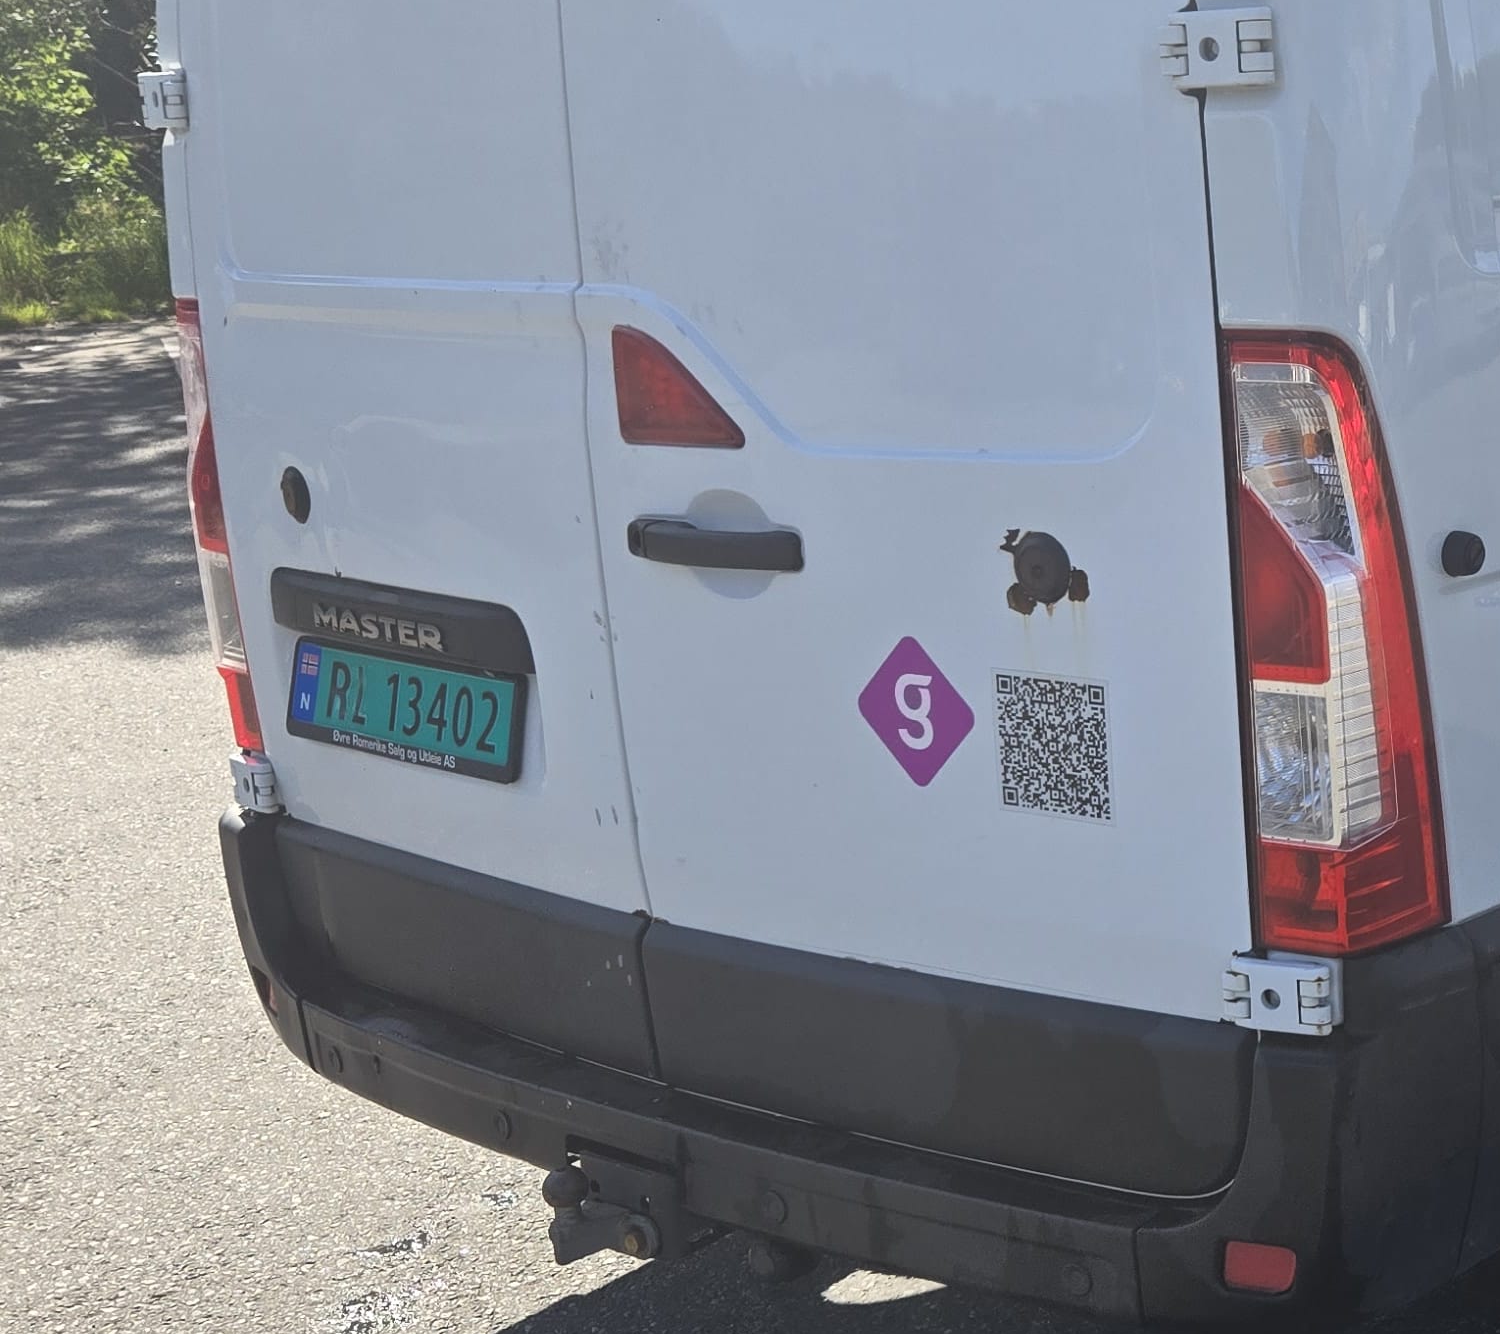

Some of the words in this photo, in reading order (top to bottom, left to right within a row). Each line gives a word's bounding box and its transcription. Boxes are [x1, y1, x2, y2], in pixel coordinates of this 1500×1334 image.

[312, 603, 445, 652] MASTER
[300, 692, 311, 711] N
[326, 660, 367, 725] RL
[386, 671, 499, 754] 13402
[894, 673, 934, 751] g
[332, 729, 351, 745] Øvre
[388, 742, 405, 761] Salg
[407, 749, 417, 763] og
[443, 754, 456, 769] AS
